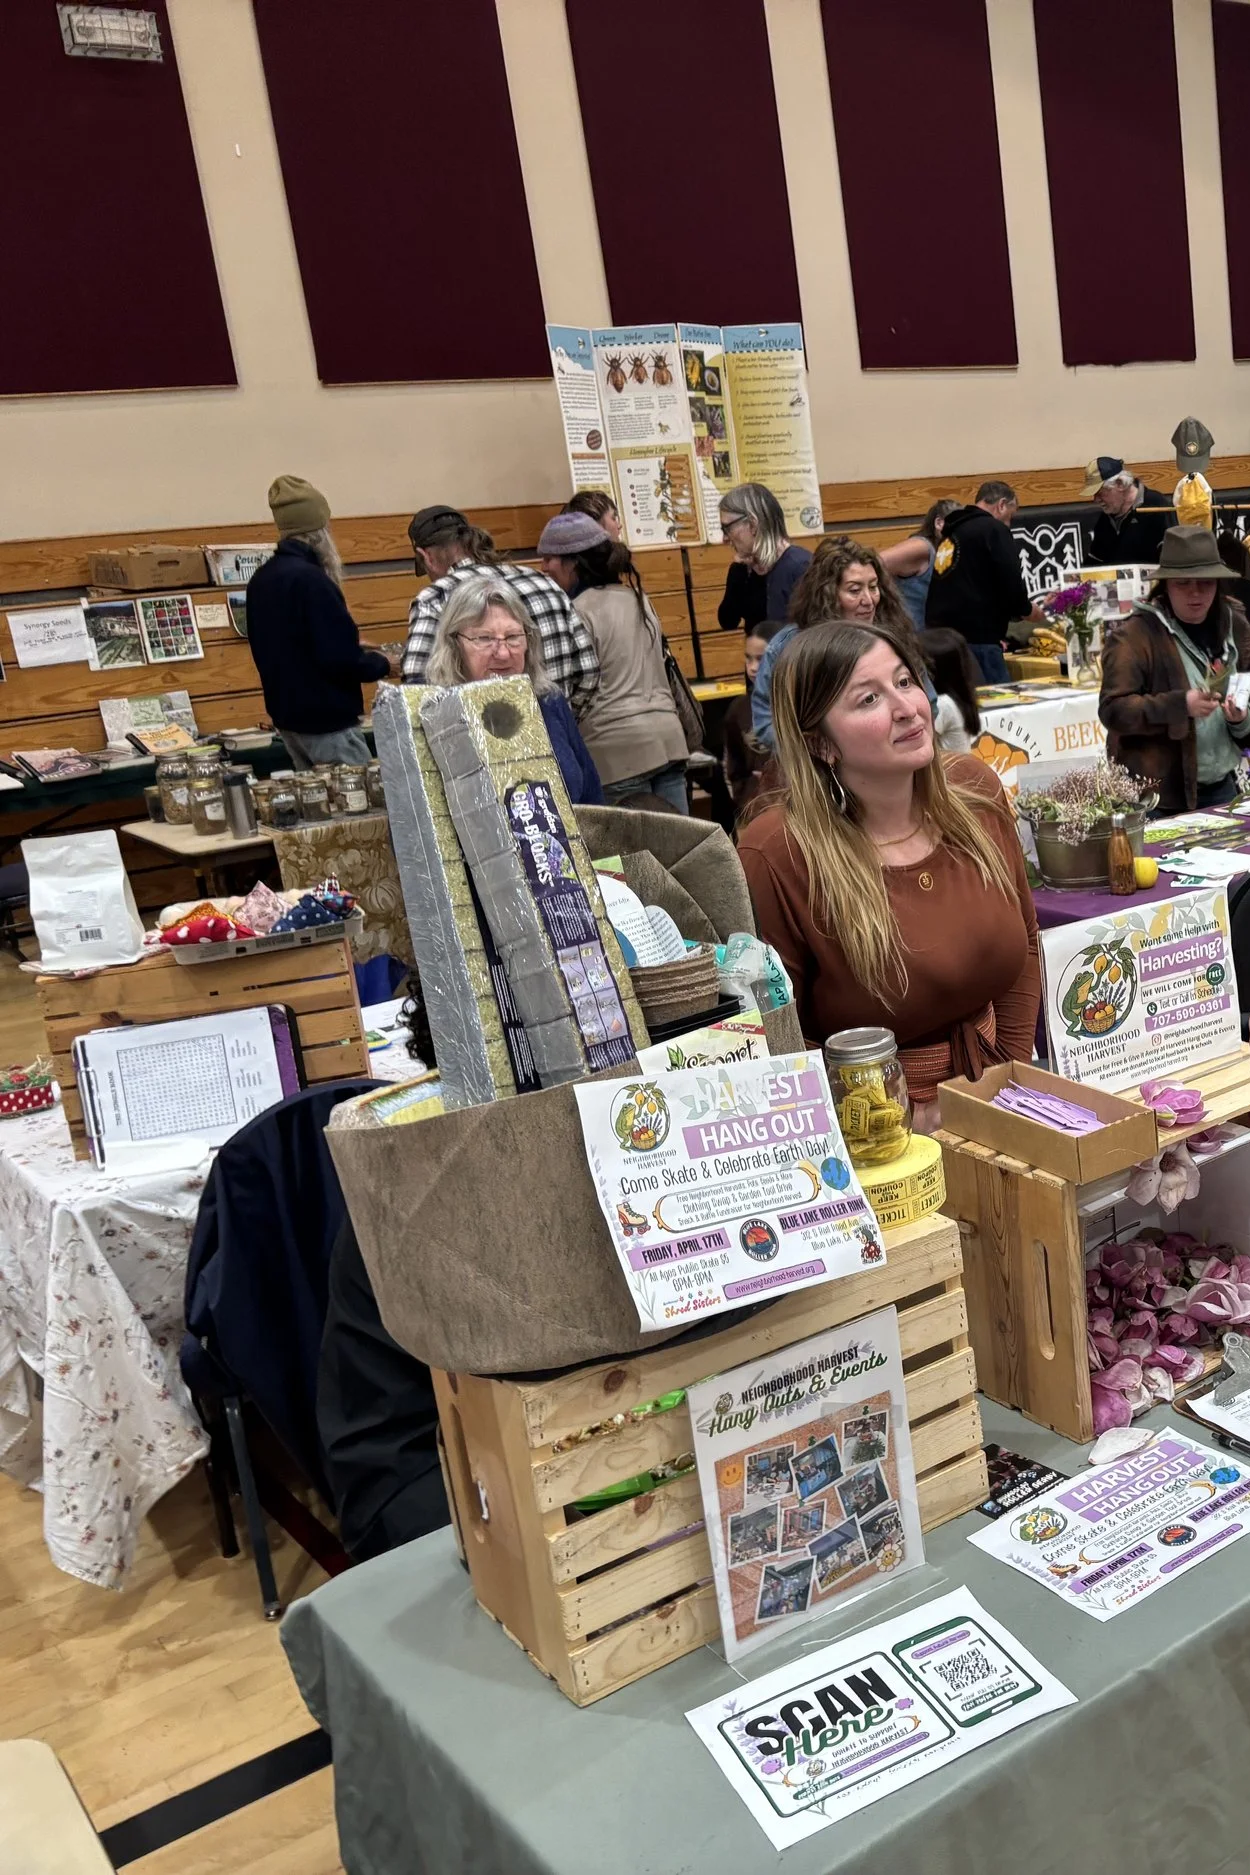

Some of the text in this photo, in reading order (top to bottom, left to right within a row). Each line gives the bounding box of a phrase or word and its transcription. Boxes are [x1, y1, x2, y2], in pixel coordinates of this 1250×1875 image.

[1000, 718, 1042, 759] COUNTY
[513, 790, 553, 886] GRO-BLOCKS
[1139, 919, 1220, 949] Want some help with
[1141, 937, 1222, 974] Harvesting?
[1142, 988, 1153, 998] WE
[1154, 985, 1171, 994] WILL
[1172, 978, 1192, 989] COME
[1160, 999, 1170, 1010] Text
[1069, 1028, 1141, 1058] NEIGHBORHOOD
[1081, 1066, 1102, 1079] Harvest
[1111, 1058, 1122, 1068] Free
[1187, 1034, 1200, 1046] Hang
[1201, 1031, 1213, 1041] Outs
[1219, 1024, 1236, 1035] Events
[1087, 1043, 1126, 1063] HARVEST
[1130, 1060, 1148, 1073] donated
[1196, 1040, 1212, 1052] schools
[694, 1071, 805, 1114] HARVEST
[700, 1117, 765, 1151] HANG
[771, 1109, 815, 1138] OUT
[620, 1137, 831, 1195] Come Skate & Celebrate Earth Day!
[871, 1182, 903, 1195] COUPON
[878, 1193, 899, 1204] KEEP
[779, 1197, 867, 1230] BLUE LAKE ROLLER RINK
[642, 1233, 724, 1265] FRIDAY, APRIL 17TH
[678, 1260, 699, 1274] Public
[665, 1302, 691, 1319] Shred
[692, 1296, 722, 1311] Sisters
[741, 1345, 860, 1405] NEIGHBORHOOD HARVEST
[708, 1350, 888, 1438] Hang Outs & Events
[1071, 1446, 1170, 1504] HARVEST
[1092, 1456, 1192, 1515] HANG OUT
[1042, 1542, 1076, 1562] Come
[1074, 1524, 1107, 1544] Skate
[1115, 1491, 1164, 1521] Celebrate
[1162, 1475, 1190, 1495] Earth
[1080, 1569, 1111, 1588] FRIDAY,
[1109, 1556, 1132, 1573] APRIL
[1115, 1589, 1138, 1606] Shred
[745, 1667, 897, 1757] SCAN
[781, 1704, 893, 1767] Here
[832, 1743, 857, 1759] DONATE
[869, 1722, 897, 1743] SUPPORT
